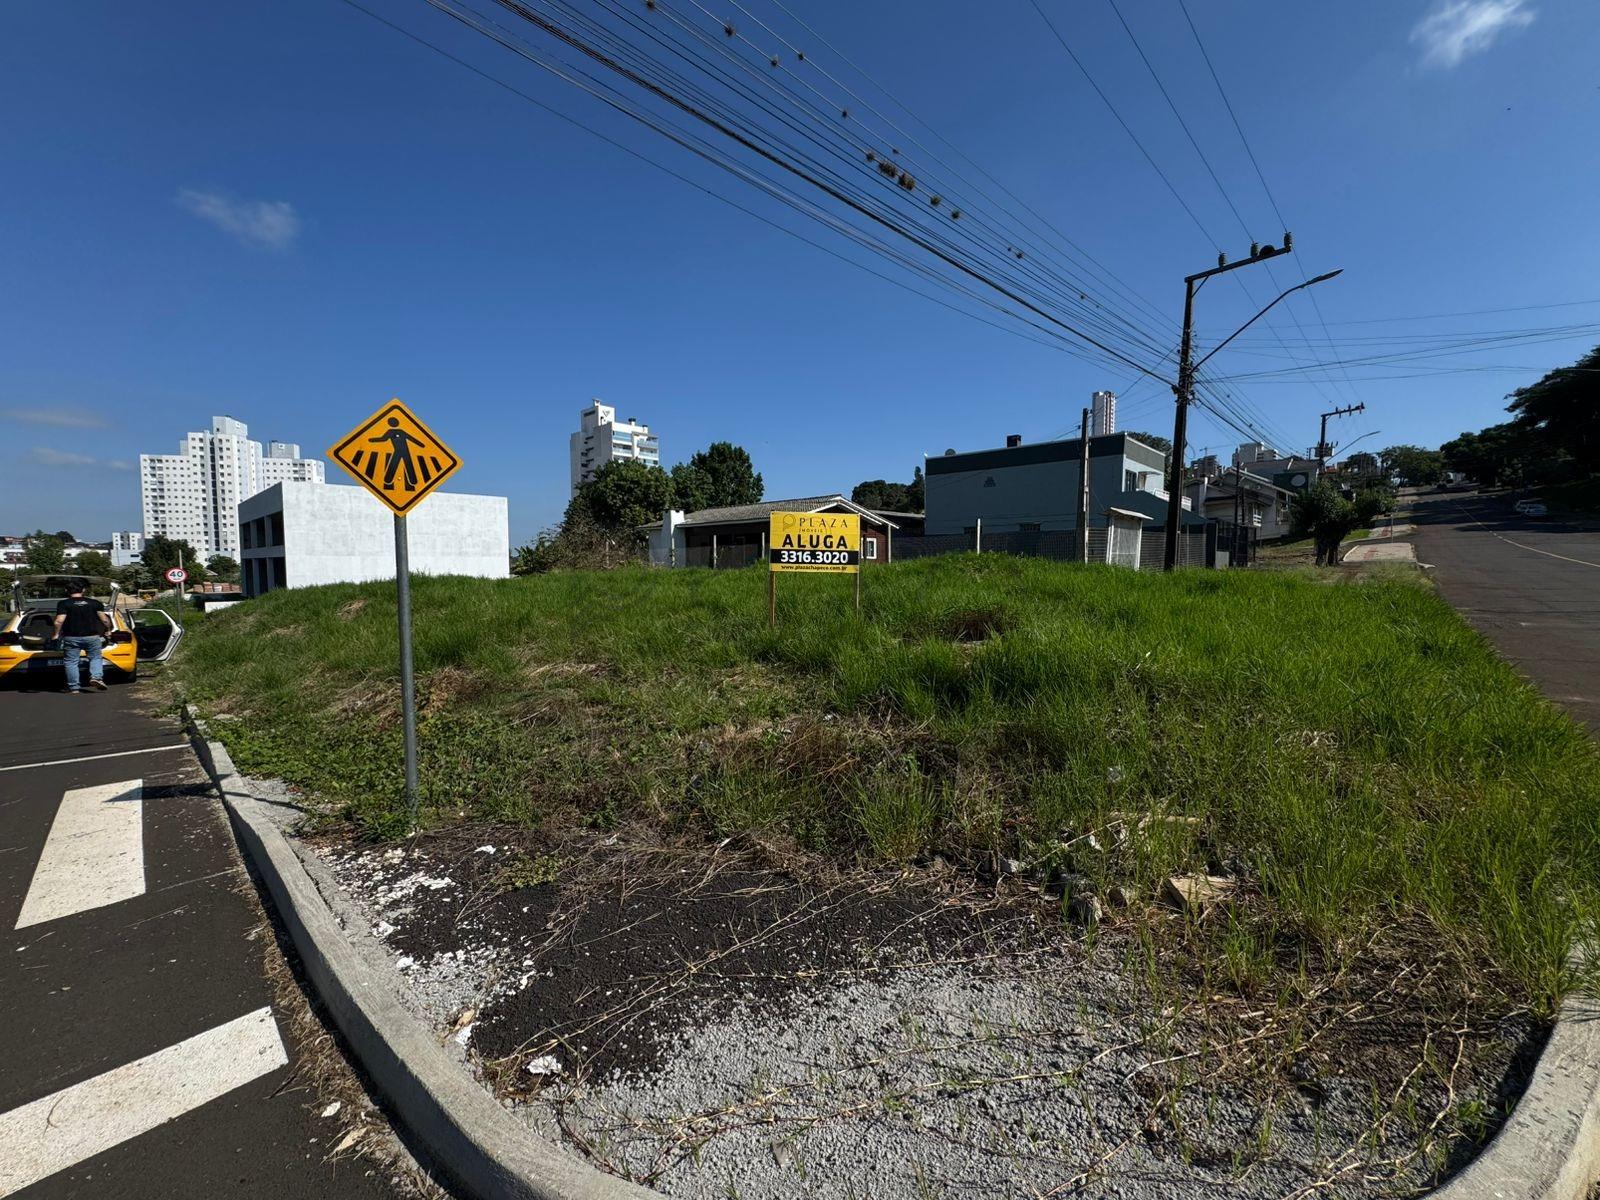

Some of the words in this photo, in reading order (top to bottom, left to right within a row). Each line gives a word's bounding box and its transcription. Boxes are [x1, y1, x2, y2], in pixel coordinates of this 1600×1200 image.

[799, 517, 848, 528] PLAZA
[782, 533, 848, 549] ALUGA
[780, 550, 849, 564] 3316.3020
[170, 570, 184, 578] 40
